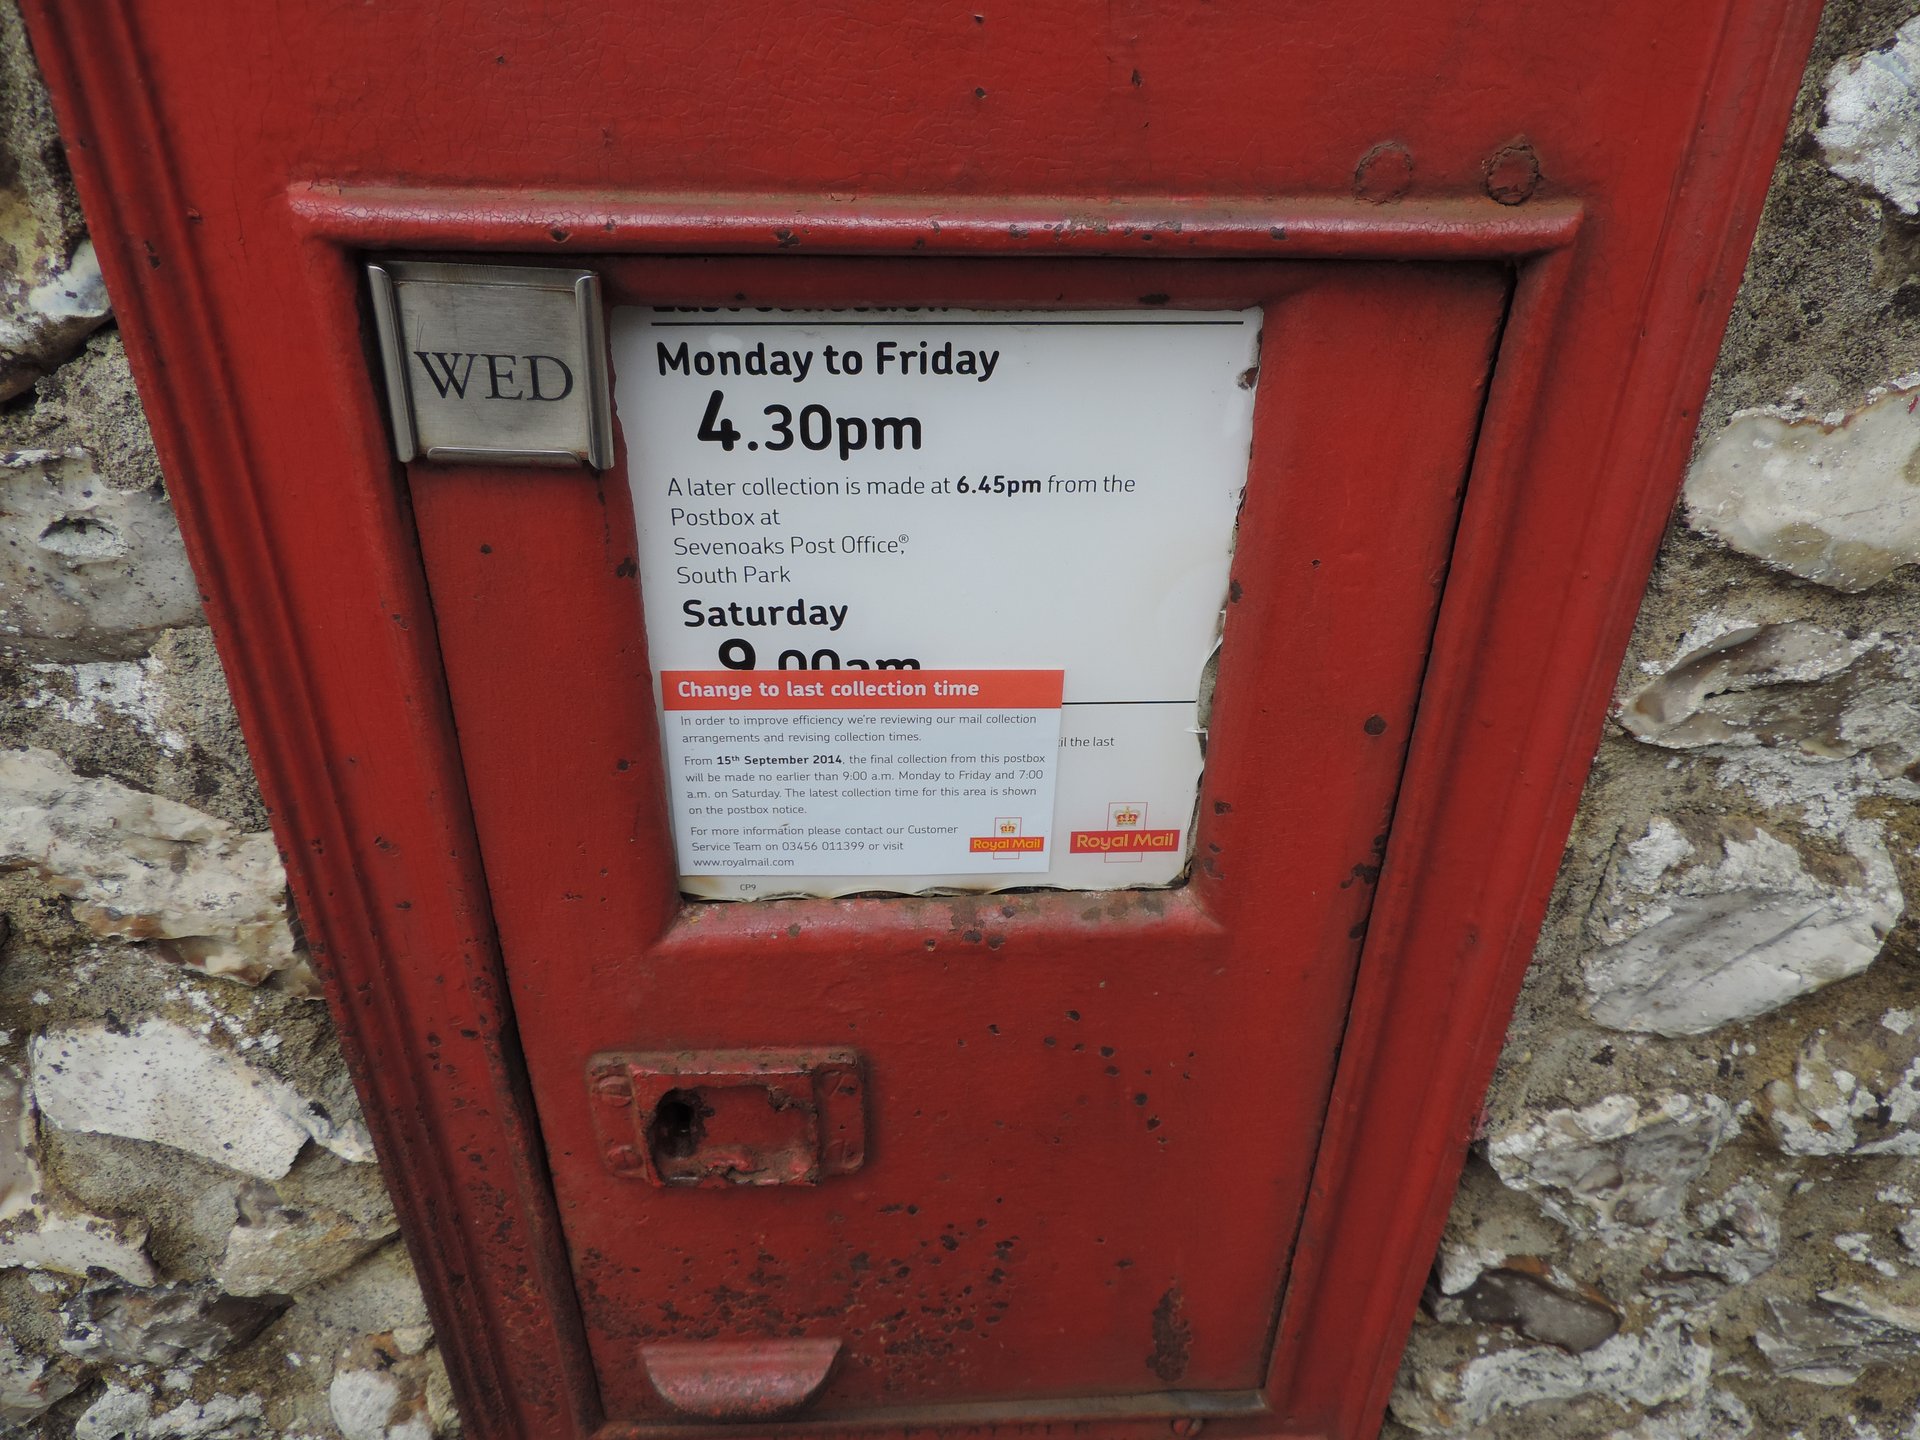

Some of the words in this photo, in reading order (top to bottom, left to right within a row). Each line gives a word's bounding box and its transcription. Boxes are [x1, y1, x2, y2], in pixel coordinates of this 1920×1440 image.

[656, 341, 813, 383] Monday
[823, 345, 863, 375] to
[877, 341, 1000, 382] Friday
[414, 351, 574, 401] WED
[697, 389, 922, 461] 4.30pm
[667, 477, 683, 497] A
[687, 478, 736, 496] later
[742, 477, 839, 496] collection
[846, 477, 861, 495] is
[866, 476, 925, 495] made
[931, 477, 951, 494] at
[956, 475, 1041, 498] 6.45pm
[1047, 474, 1097, 493] from
[1103, 474, 1136, 493] the
[671, 508, 755, 526] Postbox
[760, 509, 781, 526] at
[673, 536, 785, 556] Sevenoaks
[790, 536, 836, 554] Post
[676, 566, 737, 584] South
[744, 565, 791, 583] Park
[682, 598, 848, 631] Saturday
[678, 681, 752, 700] Change
[759, 682, 779, 697] to
[787, 681, 825, 697] last
[830, 681, 927, 697] collection
[933, 680, 979, 696] time
[681, 716, 691, 726] In
[695, 716, 725, 726] order
[729, 717, 740, 725] to
[744, 715, 789, 727] improve
[792, 715, 844, 727] efficiency
[847, 715, 877, 725] we're
[880, 715, 932, 726] reviewing
[936, 716, 956, 724] our
[959, 714, 982, 724] mail
[986, 714, 1037, 724] collection
[682, 733, 760, 745] arrangements
[763, 732, 784, 744] and
[788, 732, 830, 744] revising
[834, 732, 885, 742] collection
[888, 731, 922, 741] times.
[1070, 736, 1090, 747] the
[1093, 736, 1116, 747] last
[684, 755, 713, 766] From
[716, 755, 740, 765] 15th
[744, 755, 810, 767] September
[849, 754, 867, 764] the
[870, 754, 893, 764] final
[897, 754, 947, 764] collection
[950, 753, 976, 763] from
[980, 753, 1000, 763] this
[1003, 754, 1045, 765] postbox
[685, 773, 704, 782] will
[707, 772, 721, 782] be
[724, 772, 755, 782] made
[758, 774, 773, 782] no
[776, 772, 811, 782] earlier
[814, 771, 839, 781] than
[842, 771, 868, 781] 9:00
[871, 773, 894, 781] a.m.
[898, 771, 941, 782] Monday
[944, 771, 955, 780] to
[959, 770, 992, 782] Friday
[994, 770, 1015, 780] and
[1018, 770, 1044, 780] 7:00
[686, 791, 711, 799] a.m.
[714, 791, 728, 799] on
[731, 788, 782, 800] Saturday.
[784, 788, 806, 798] The
[809, 788, 839, 798] latest
[841, 787, 891, 798] collection
[894, 787, 919, 797] time
[922, 787, 937, 797] for
[940, 787, 960, 796] this
[990, 786, 999, 796] is
[1002, 786, 1037, 796] shown
[688, 807, 703, 815] on
[705, 805, 724, 815] the
[727, 805, 769, 816] postbox
[772, 805, 807, 814] notice.
[690, 826, 708, 836] For
[711, 828, 739, 836] more
[743, 825, 804, 835] information
[808, 826, 841, 837] please
[844, 826, 884, 835] contact
[886, 827, 905, 835] our
[907, 824, 959, 834] Customer
[691, 842, 731, 851] Service
[733, 842, 762, 851] Team
[782, 841, 818, 851] 03456
[821, 841, 865, 851] 011399
[868, 843, 880, 851] or
[882, 841, 904, 851] visit
[974, 839, 1009, 851] Royal
[1012, 838, 1040, 849] Mail
[1076, 833, 1128, 850] Royal
[1132, 832, 1174, 847] Mail
[693, 857, 795, 868] www.royalmail.com
